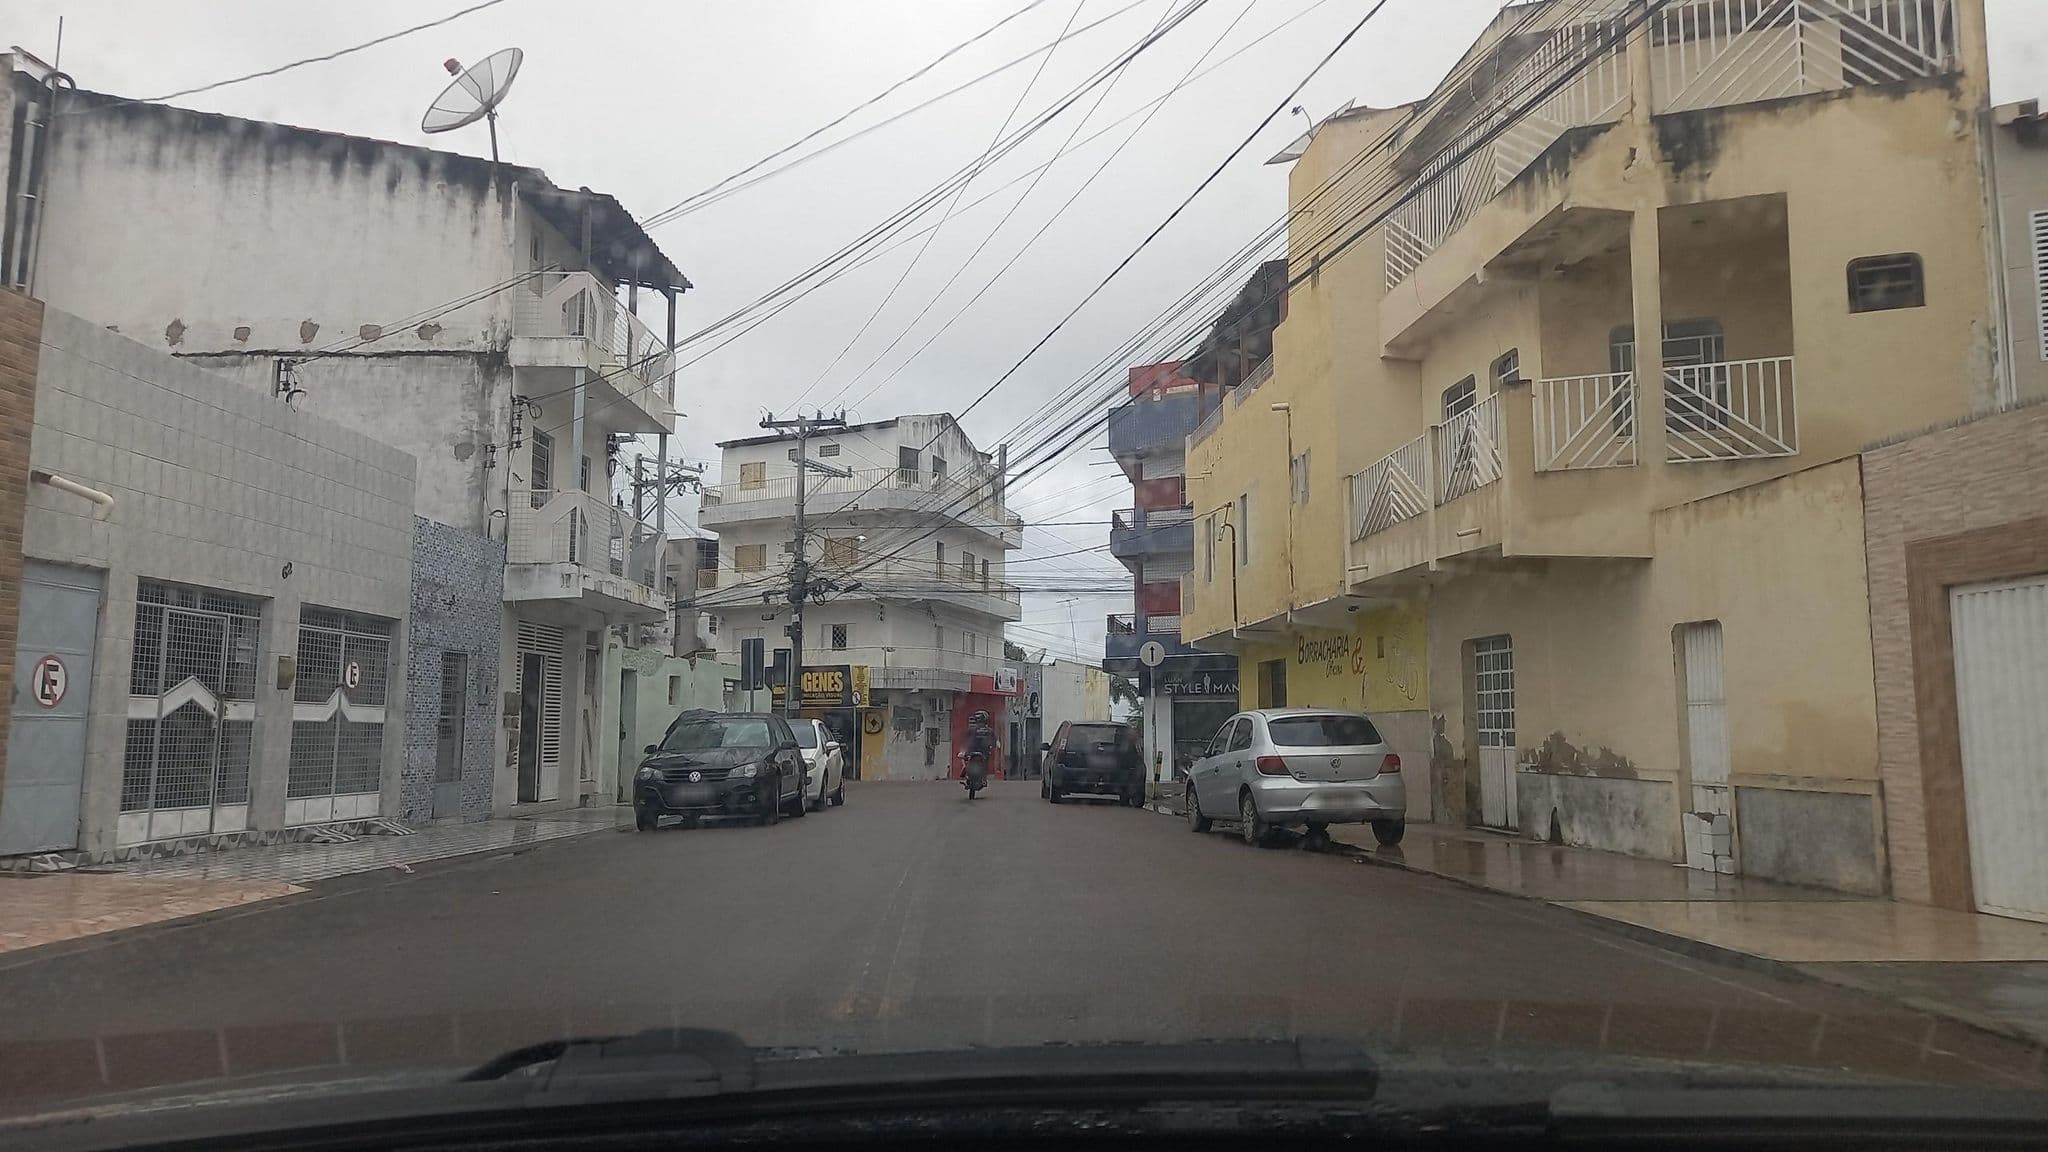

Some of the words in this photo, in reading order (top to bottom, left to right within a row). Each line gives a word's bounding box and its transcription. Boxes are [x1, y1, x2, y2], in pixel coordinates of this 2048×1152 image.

[282, 561, 293, 579] 62
[1164, 683, 1202, 694] STYLE
[1213, 683, 1239, 694] MAN
